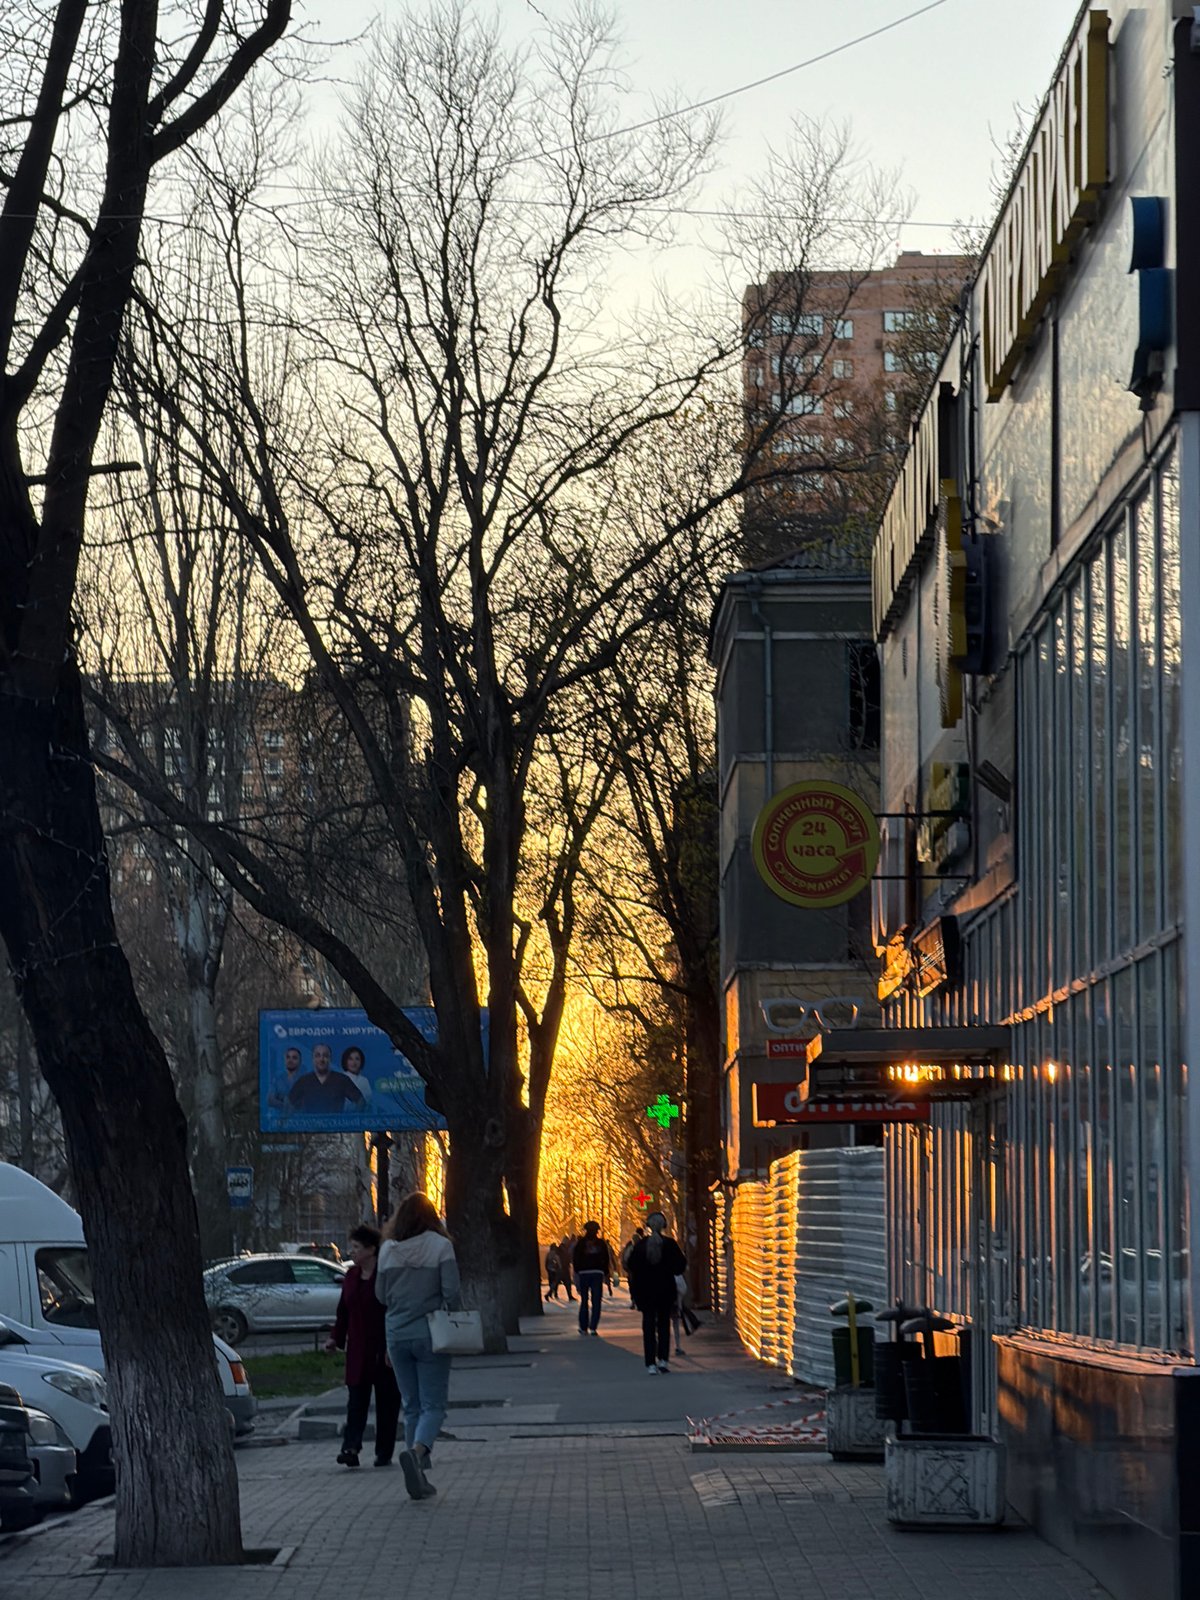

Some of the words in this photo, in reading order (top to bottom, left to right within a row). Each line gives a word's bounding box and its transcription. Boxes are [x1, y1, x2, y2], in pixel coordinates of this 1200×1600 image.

[980, 11, 1095, 398] СУПЕРМАРКЕТ
[767, 797, 835, 851] СОЛНЕЧНЫЙ
[836, 804, 863, 839] КРУГ
[802, 821, 827, 836] 24
[792, 844, 836, 857] часа
[774, 860, 853, 892] СУПЕРМАРКЕТ
[288, 1026, 335, 1037] ЕВРОДОН
